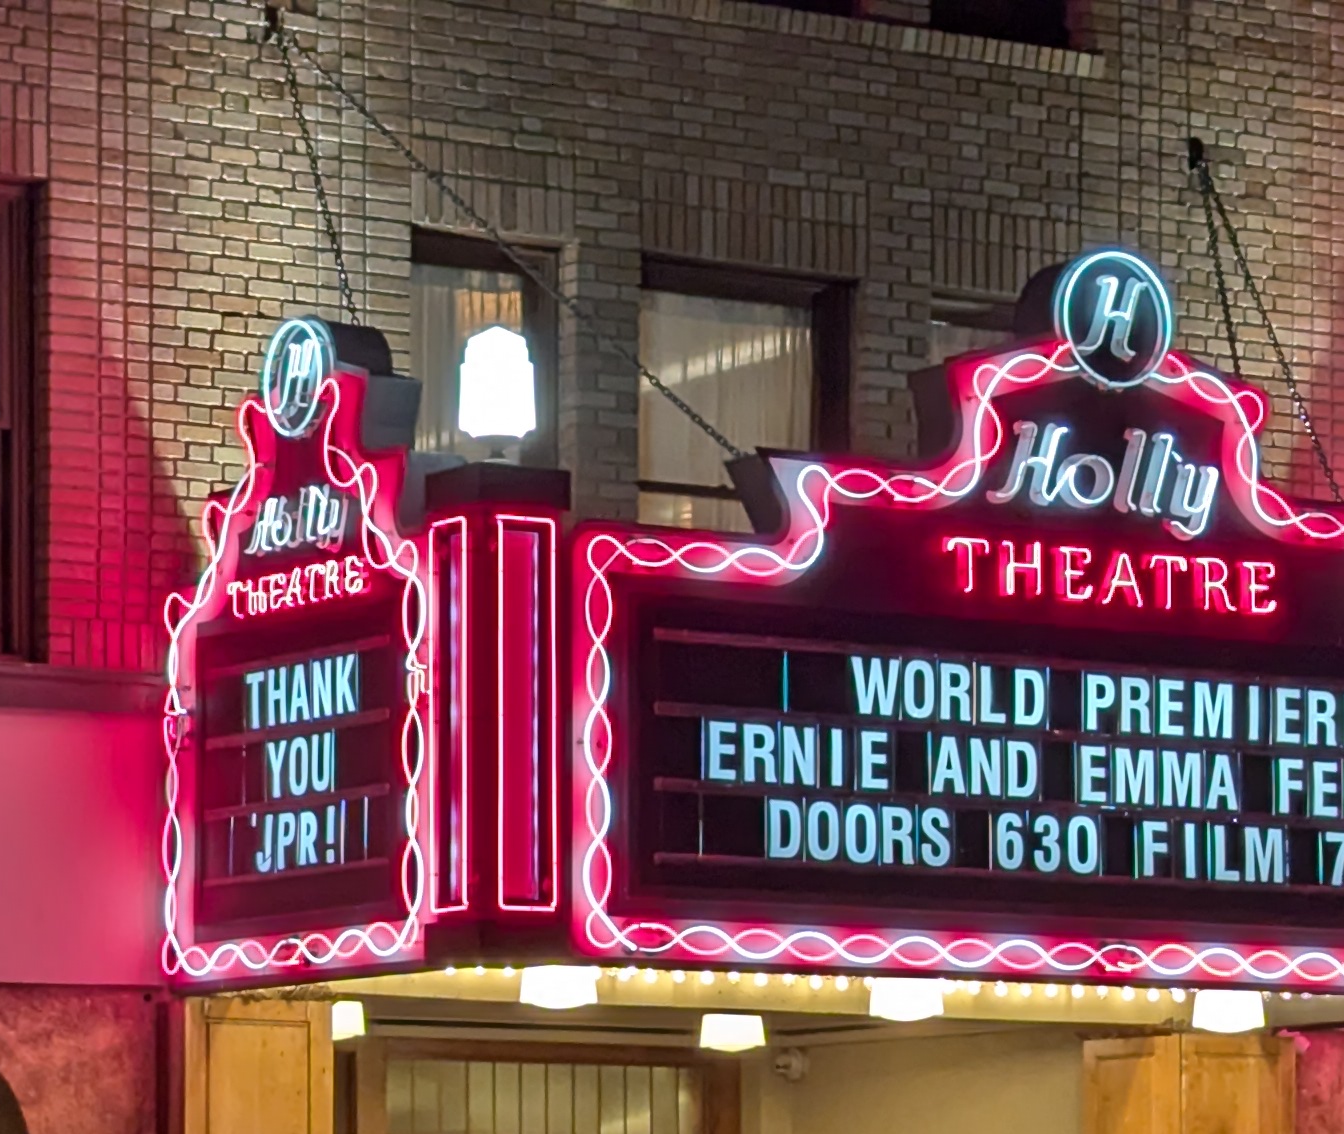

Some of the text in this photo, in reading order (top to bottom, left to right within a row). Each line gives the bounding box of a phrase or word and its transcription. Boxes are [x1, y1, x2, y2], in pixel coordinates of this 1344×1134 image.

[1076, 275, 1149, 362] H
[244, 483, 349, 554] Holly
[986, 420, 1220, 540] Holly
[227, 555, 368, 618] THEATRE
[940, 536, 1278, 614] THEATRE
[245, 653, 357, 730] THANK
[851, 655, 1046, 727] WORLD
[266, 731, 333, 799] YOU
[707, 720, 890, 791] ERNIE
[931, 734, 1039, 799] AND
[1079, 744, 1240, 812] EMMA
[767, 798, 952, 867] DOORS
[996, 812, 1099, 875] 630
[1141, 820, 1284, 884] FILM
